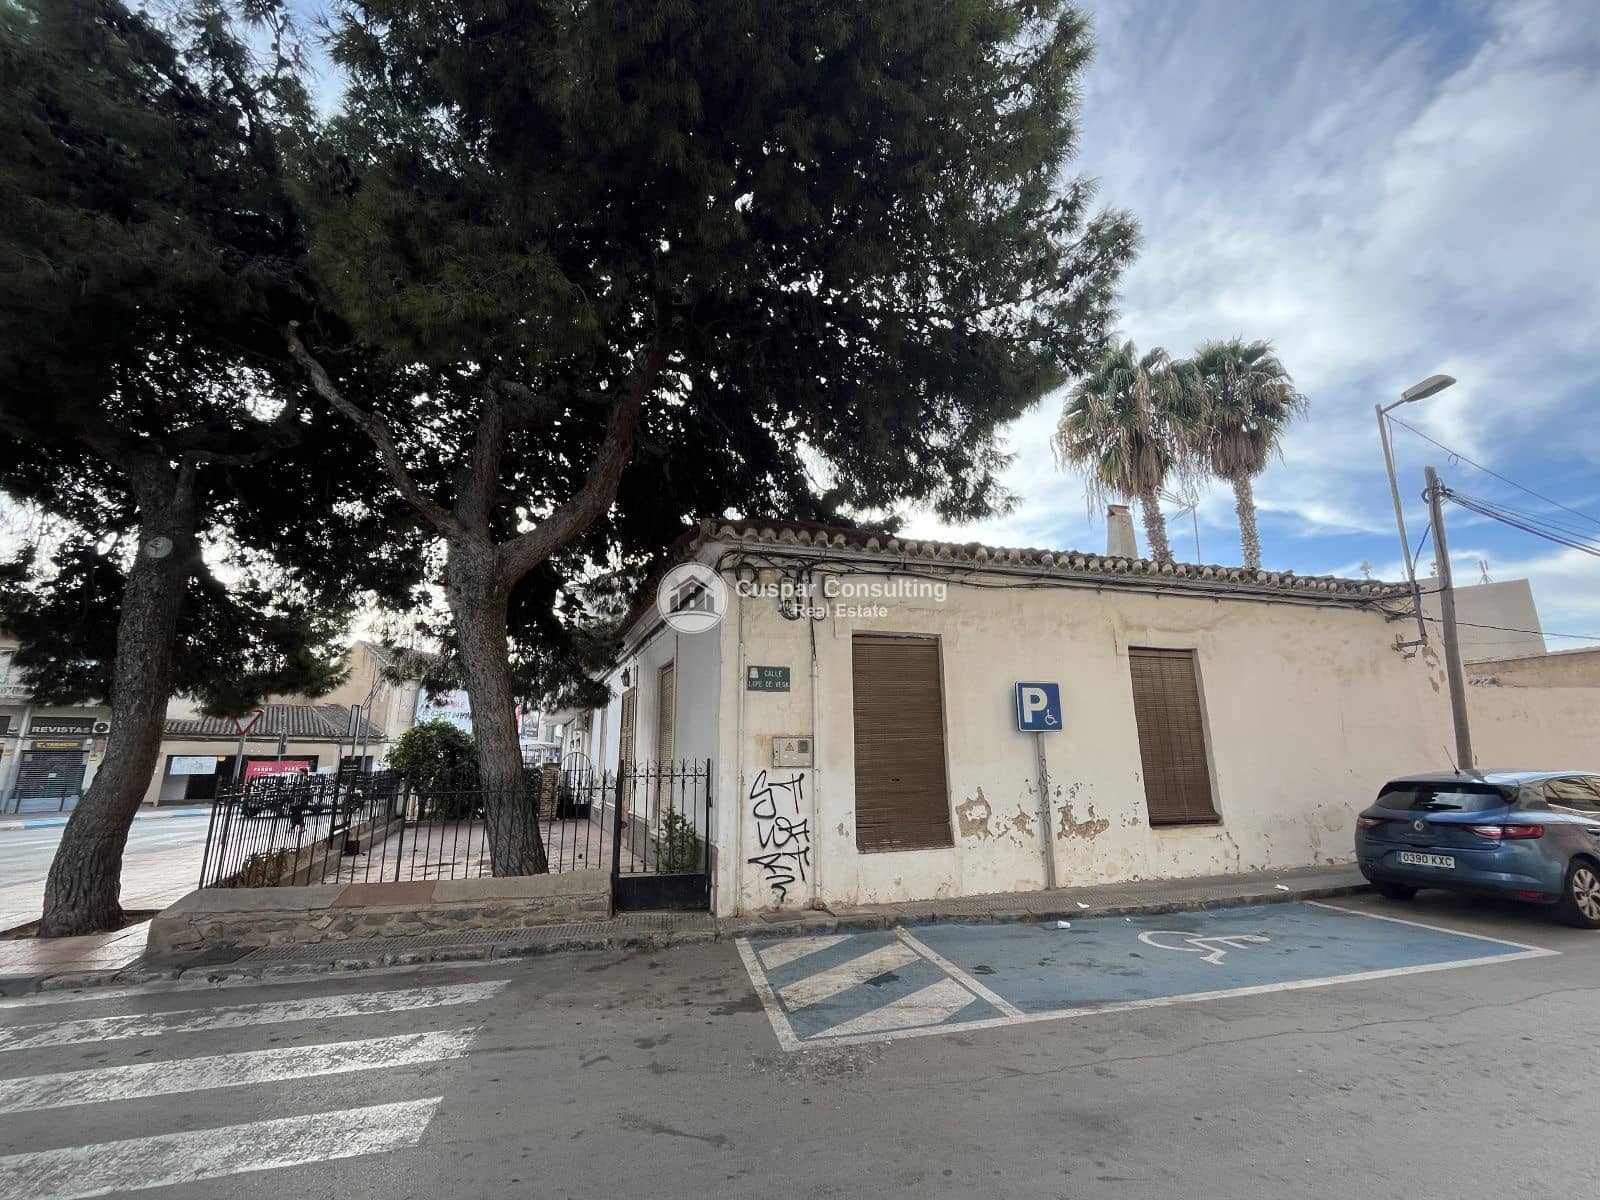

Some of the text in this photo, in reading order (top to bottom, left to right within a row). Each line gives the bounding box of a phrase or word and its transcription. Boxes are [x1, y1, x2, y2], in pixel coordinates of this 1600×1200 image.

[1021, 687, 1048, 723] P
[1403, 853, 1452, 867] 0390 KXC
